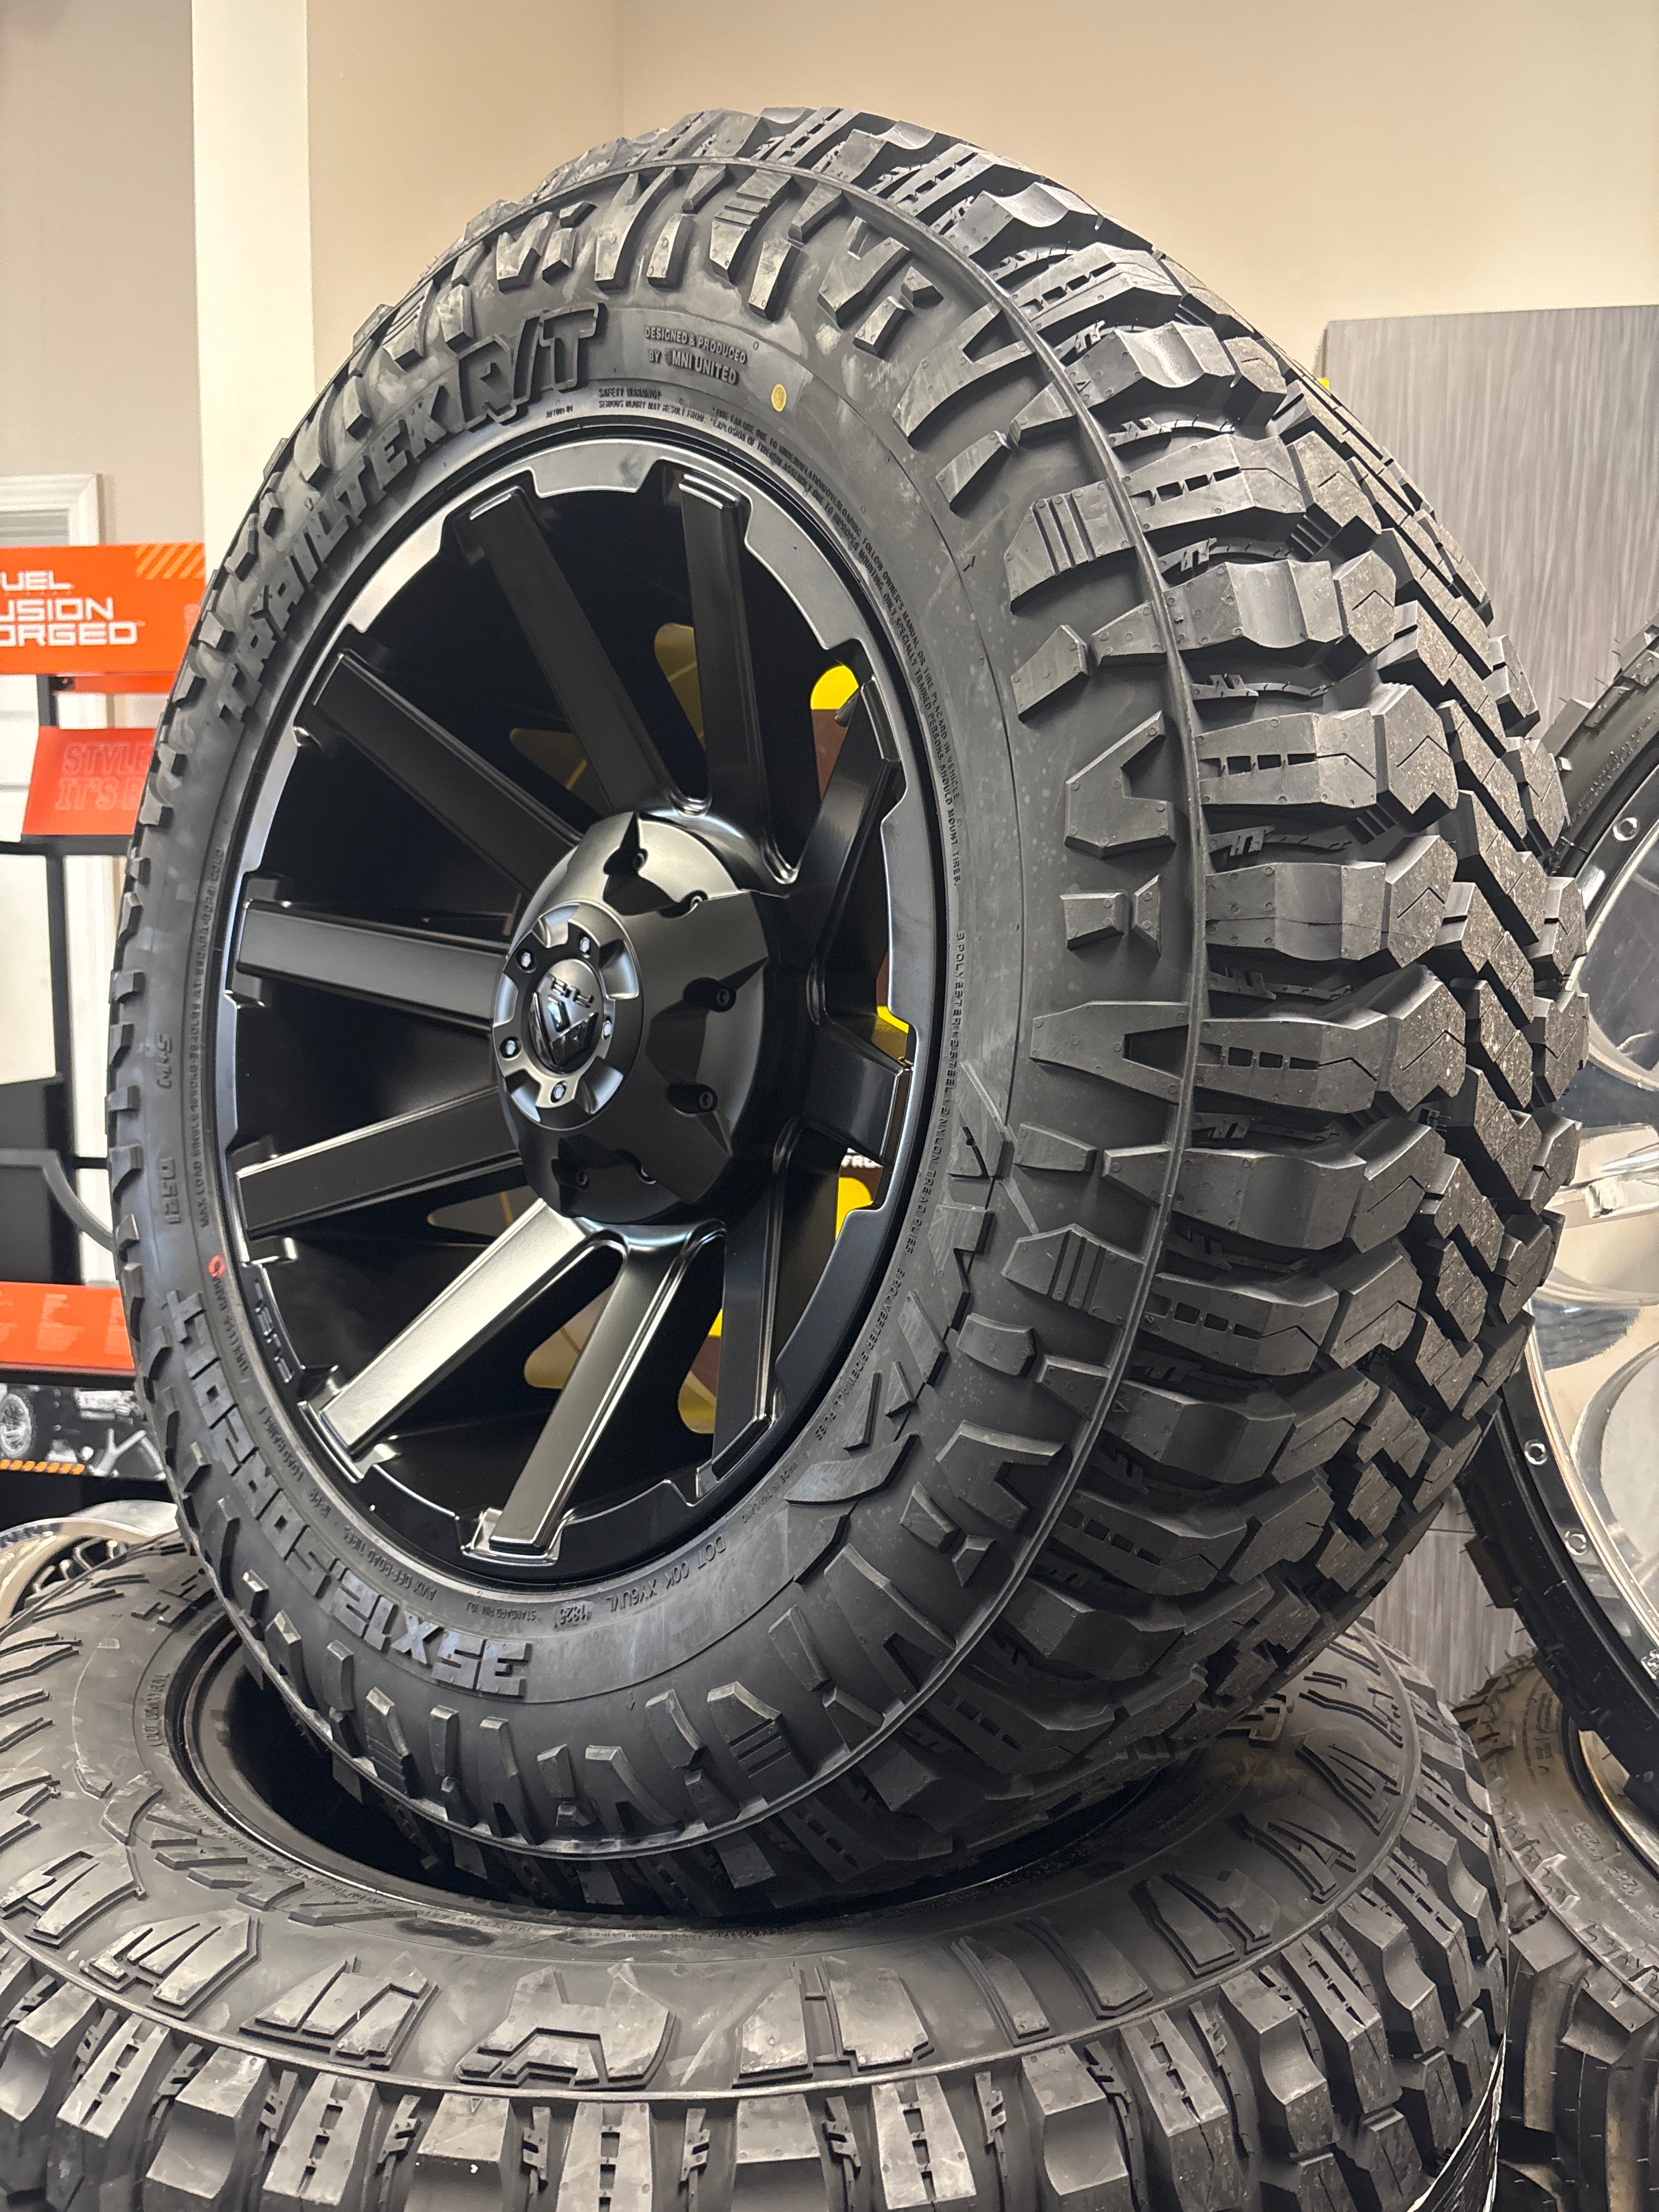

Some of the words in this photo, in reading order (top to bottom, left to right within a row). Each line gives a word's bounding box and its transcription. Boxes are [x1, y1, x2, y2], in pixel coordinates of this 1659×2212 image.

[645, 327, 689, 345] DESIGNED
[689, 336, 696, 346] &
[697, 336, 747, 364] PRODUCED
[649, 350, 661, 363] BY
[695, 357, 737, 384] UNITED
[599, 387, 624, 398] SAFETY
[599, 399, 623, 409] SERIOUS
[625, 400, 646, 408] INJURY
[648, 401, 661, 410] MAY
[662, 403, 685, 416] RESULT
[217, 385, 448, 721] TRAILTEK
[456, 302, 598, 427] R/T
[754, 428, 769, 442] DUE
[768, 437, 779, 449] TO
[860, 537, 885, 571] FOLLOW
[881, 571, 905, 611] OWNER'S
[900, 611, 921, 649] MANUAL
[916, 650, 927, 666] OR
[922, 667, 935, 690] TIRE
[929, 692, 948, 740] PLACARD
[943, 742, 951, 753] IN
[746, 435, 757, 447] OF
[782, 462, 813, 491] ASSEMBLY
[810, 489, 826, 504] DUE
[822, 502, 835, 515] TO
[831, 512, 861, 550] IMPROPER
[882, 592, 897, 616] ONLY
[893, 617, 918, 665] SPECIALLY
[913, 668, 932, 710] TRAINED
[927, 713, 944, 760] PERSONS
[939, 764, 952, 805] SHOULD
[946, 808, 957, 844] MOUNT
[952, 850, 961, 885] TIRES.
[952, 944, 964, 1025] POLYESTER
[944, 1051, 958, 1094] STEEL
[930, 1118, 948, 1163] NYLON
[917, 1169, 936, 1213] TREAD
[904, 1217, 923, 1254] PLIES
[896, 1268, 906, 1277] 3
[864, 1278, 902, 1350] POLYESTER
[833, 1351, 870, 1408] SIDEWALL
[812, 1408, 838, 1441] PLIES
[691, 1534, 730, 1570] DOT
